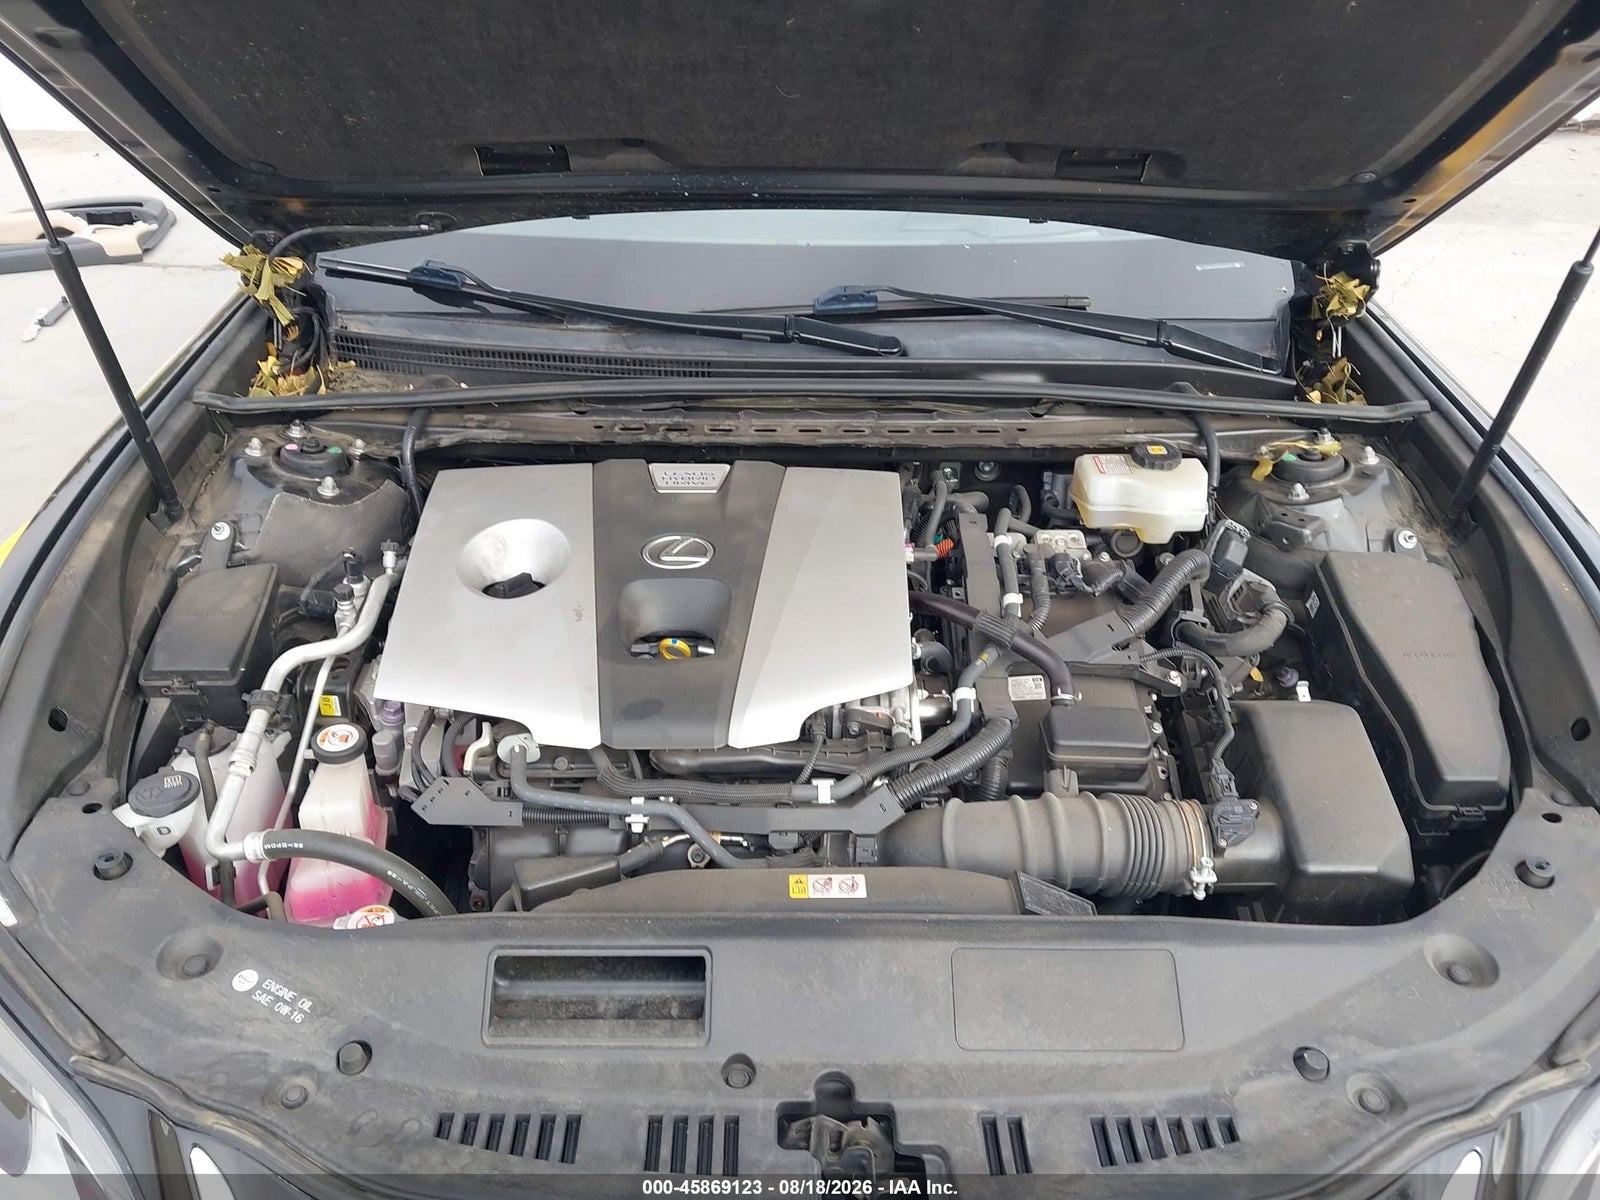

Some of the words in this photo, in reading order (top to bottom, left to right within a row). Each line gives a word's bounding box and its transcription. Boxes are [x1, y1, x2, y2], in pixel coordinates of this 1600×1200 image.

[251, 989, 274, 1007] SAE
[273, 1001, 305, 1024] 0W-16
[261, 978, 298, 1003] ENGINE
[297, 998, 313, 1013] OIL
